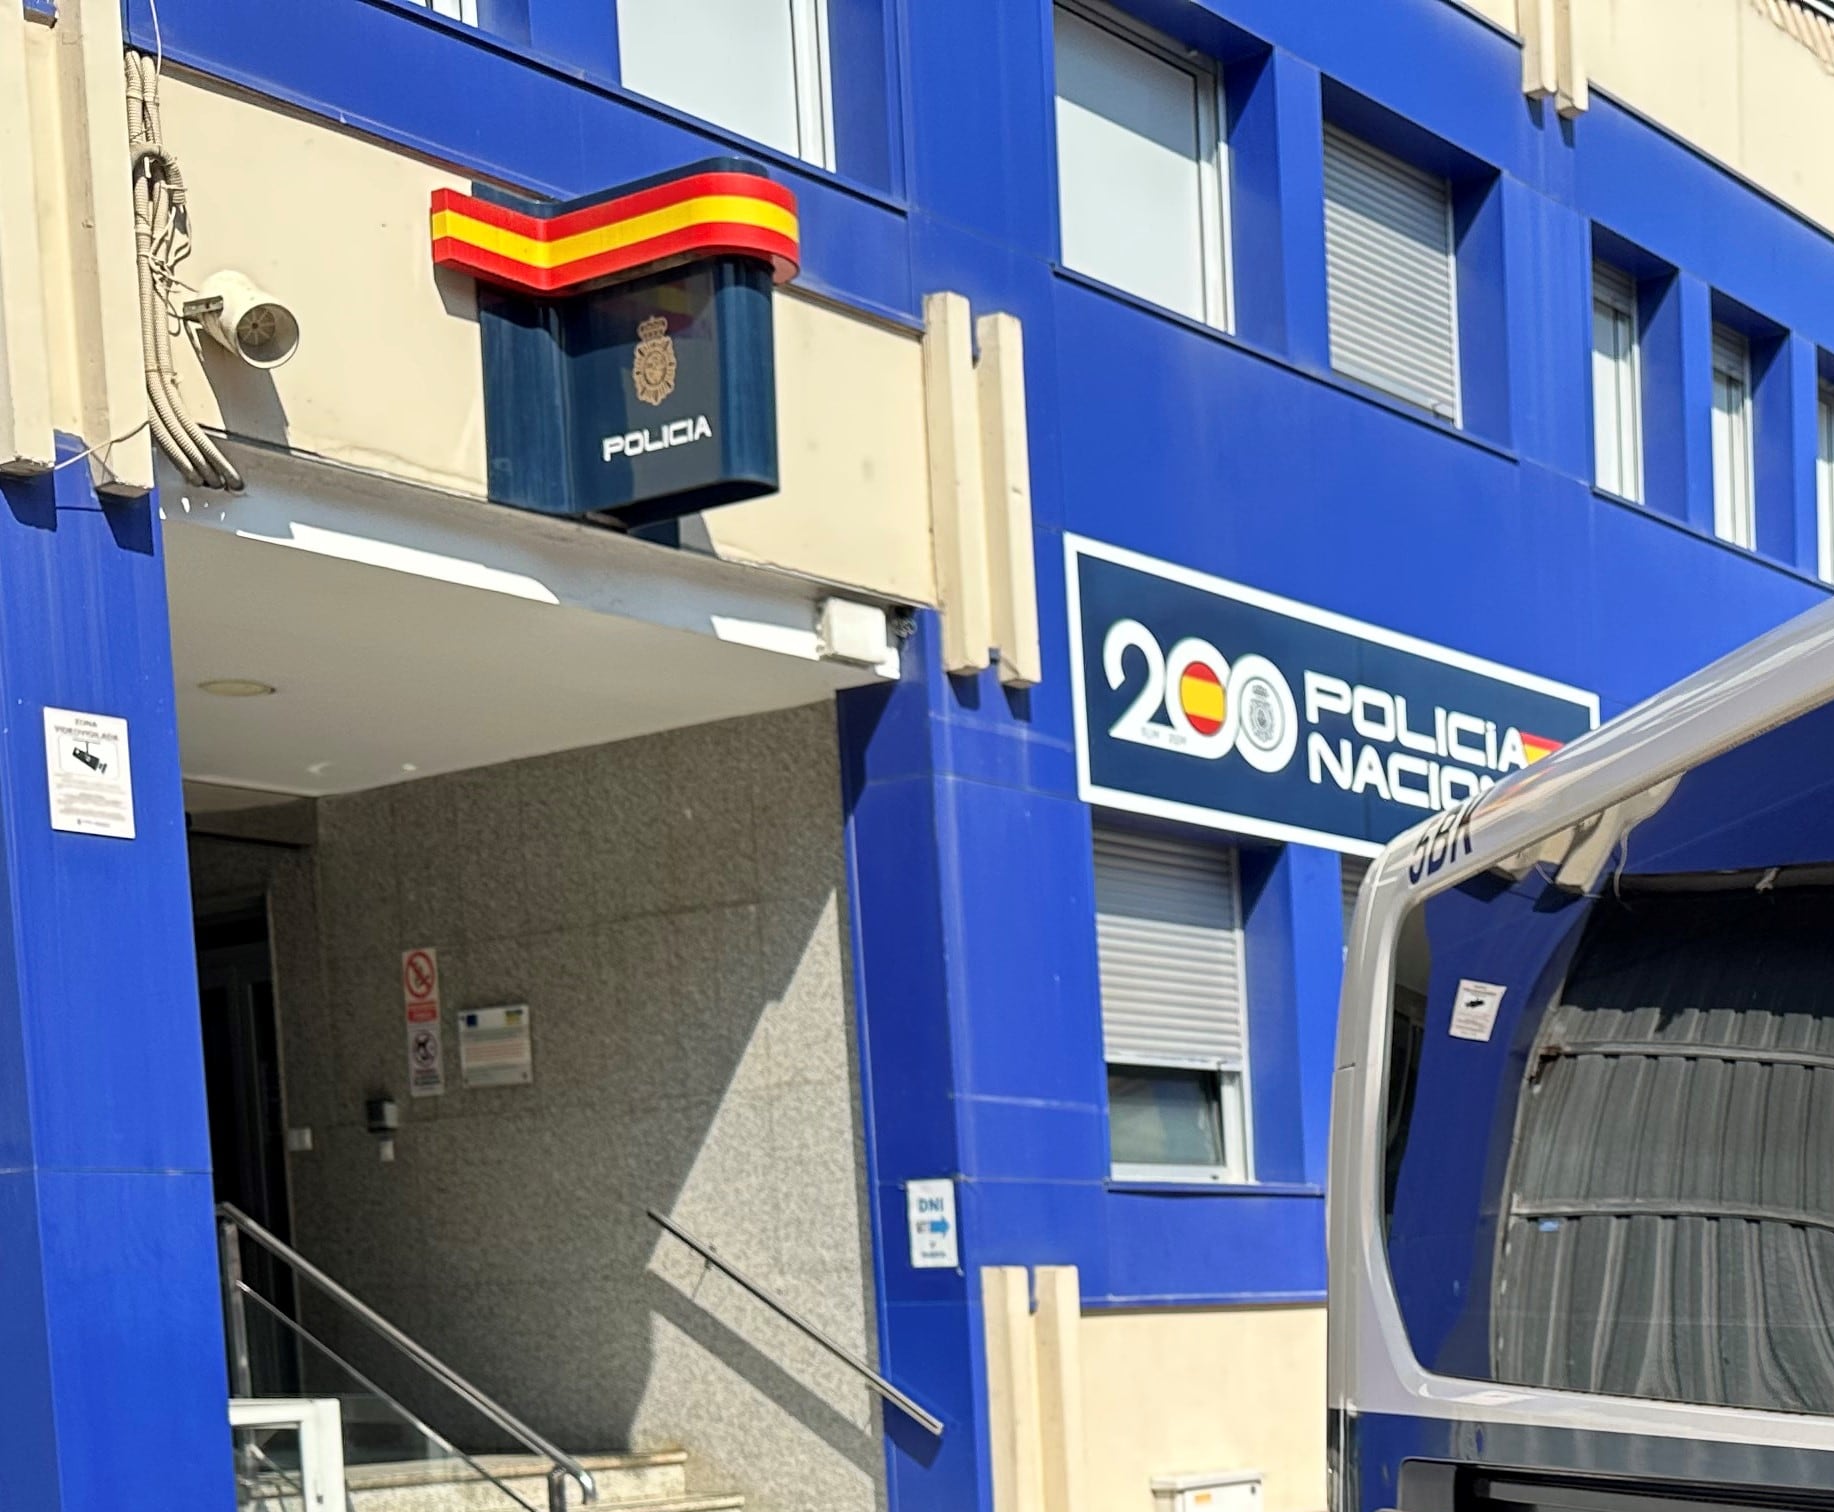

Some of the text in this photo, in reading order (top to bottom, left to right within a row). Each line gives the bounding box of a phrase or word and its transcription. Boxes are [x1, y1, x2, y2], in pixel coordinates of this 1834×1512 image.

[602, 415, 713, 462] POLICIA
[1103, 618, 1299, 773] 200
[918, 1197, 944, 1212] DNI
